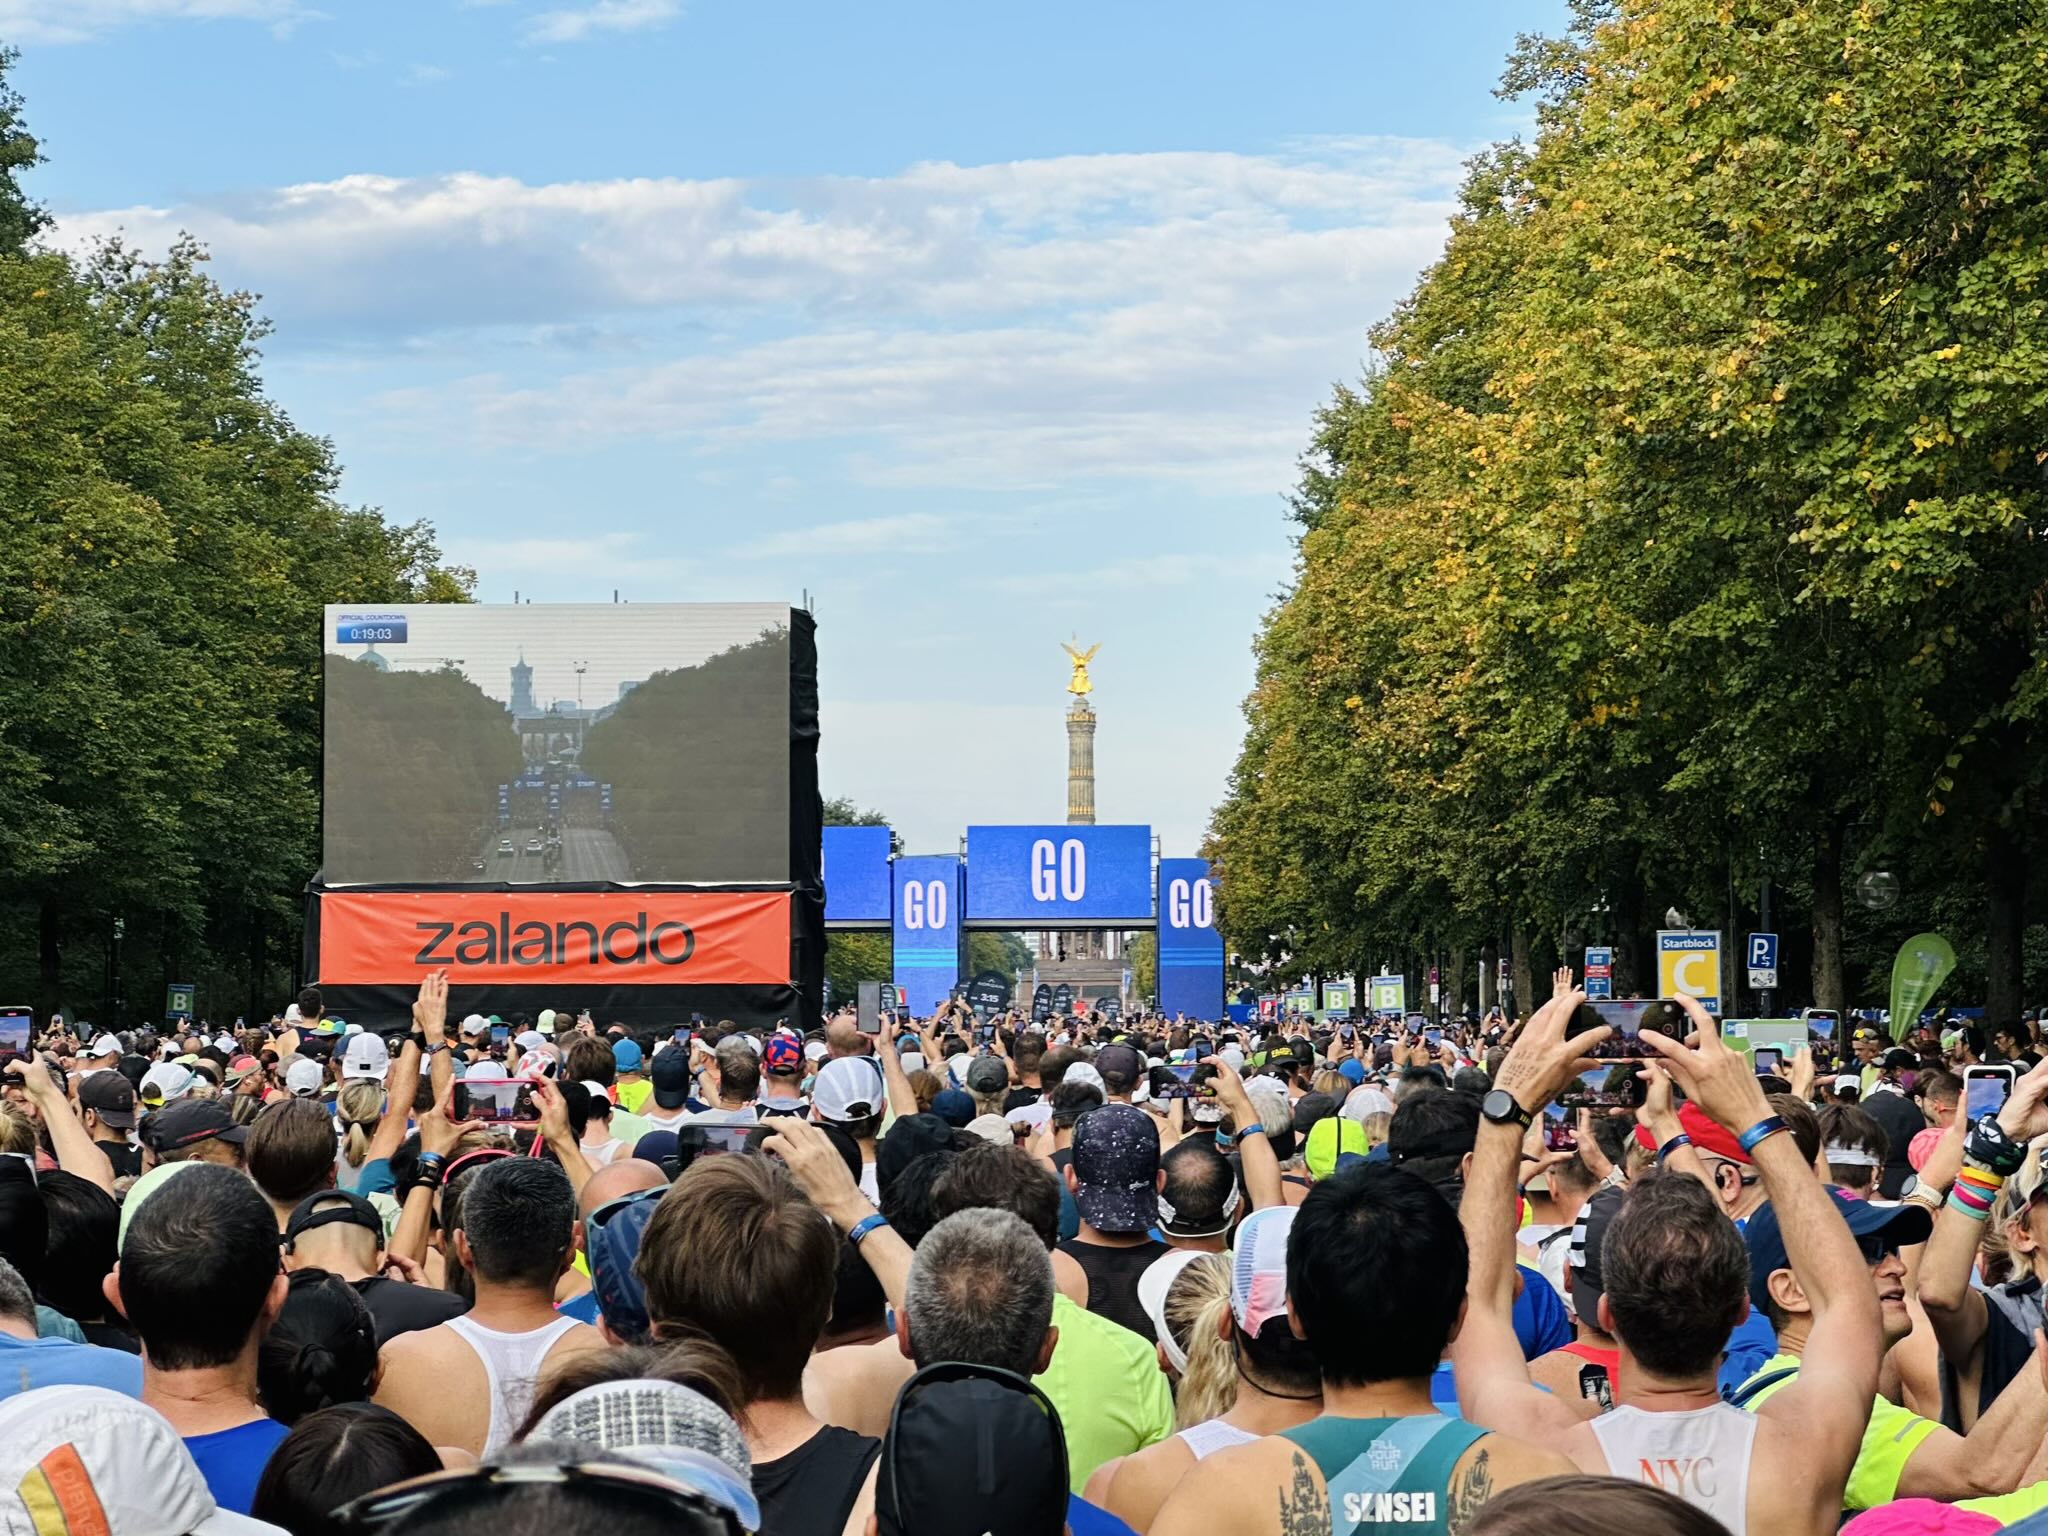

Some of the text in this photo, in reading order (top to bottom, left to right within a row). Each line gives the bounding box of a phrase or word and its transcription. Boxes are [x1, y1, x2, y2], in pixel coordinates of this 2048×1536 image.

[337, 613, 407, 621] OFFICIAL COUNTDOWN
[350, 627, 392, 640] 0:19:03
[1031, 838, 1086, 902] GO
[904, 880, 947, 930] GO
[1169, 878, 1213, 929] GO
[415, 911, 695, 966] zalando
[1663, 938, 1715, 949] Startblock
[1752, 938, 1770, 965] P
[1672, 953, 1706, 997] C
[173, 992, 187, 1011] B
[1298, 997, 1310, 1012] B
[1329, 991, 1344, 1009] B
[1381, 986, 1397, 1008] B
[1367, 1449, 1401, 1460] YOUR
[1371, 1460, 1399, 1471] RUN
[1637, 1456, 1717, 1498] NYC
[1342, 1491, 1436, 1523] SENSEI
